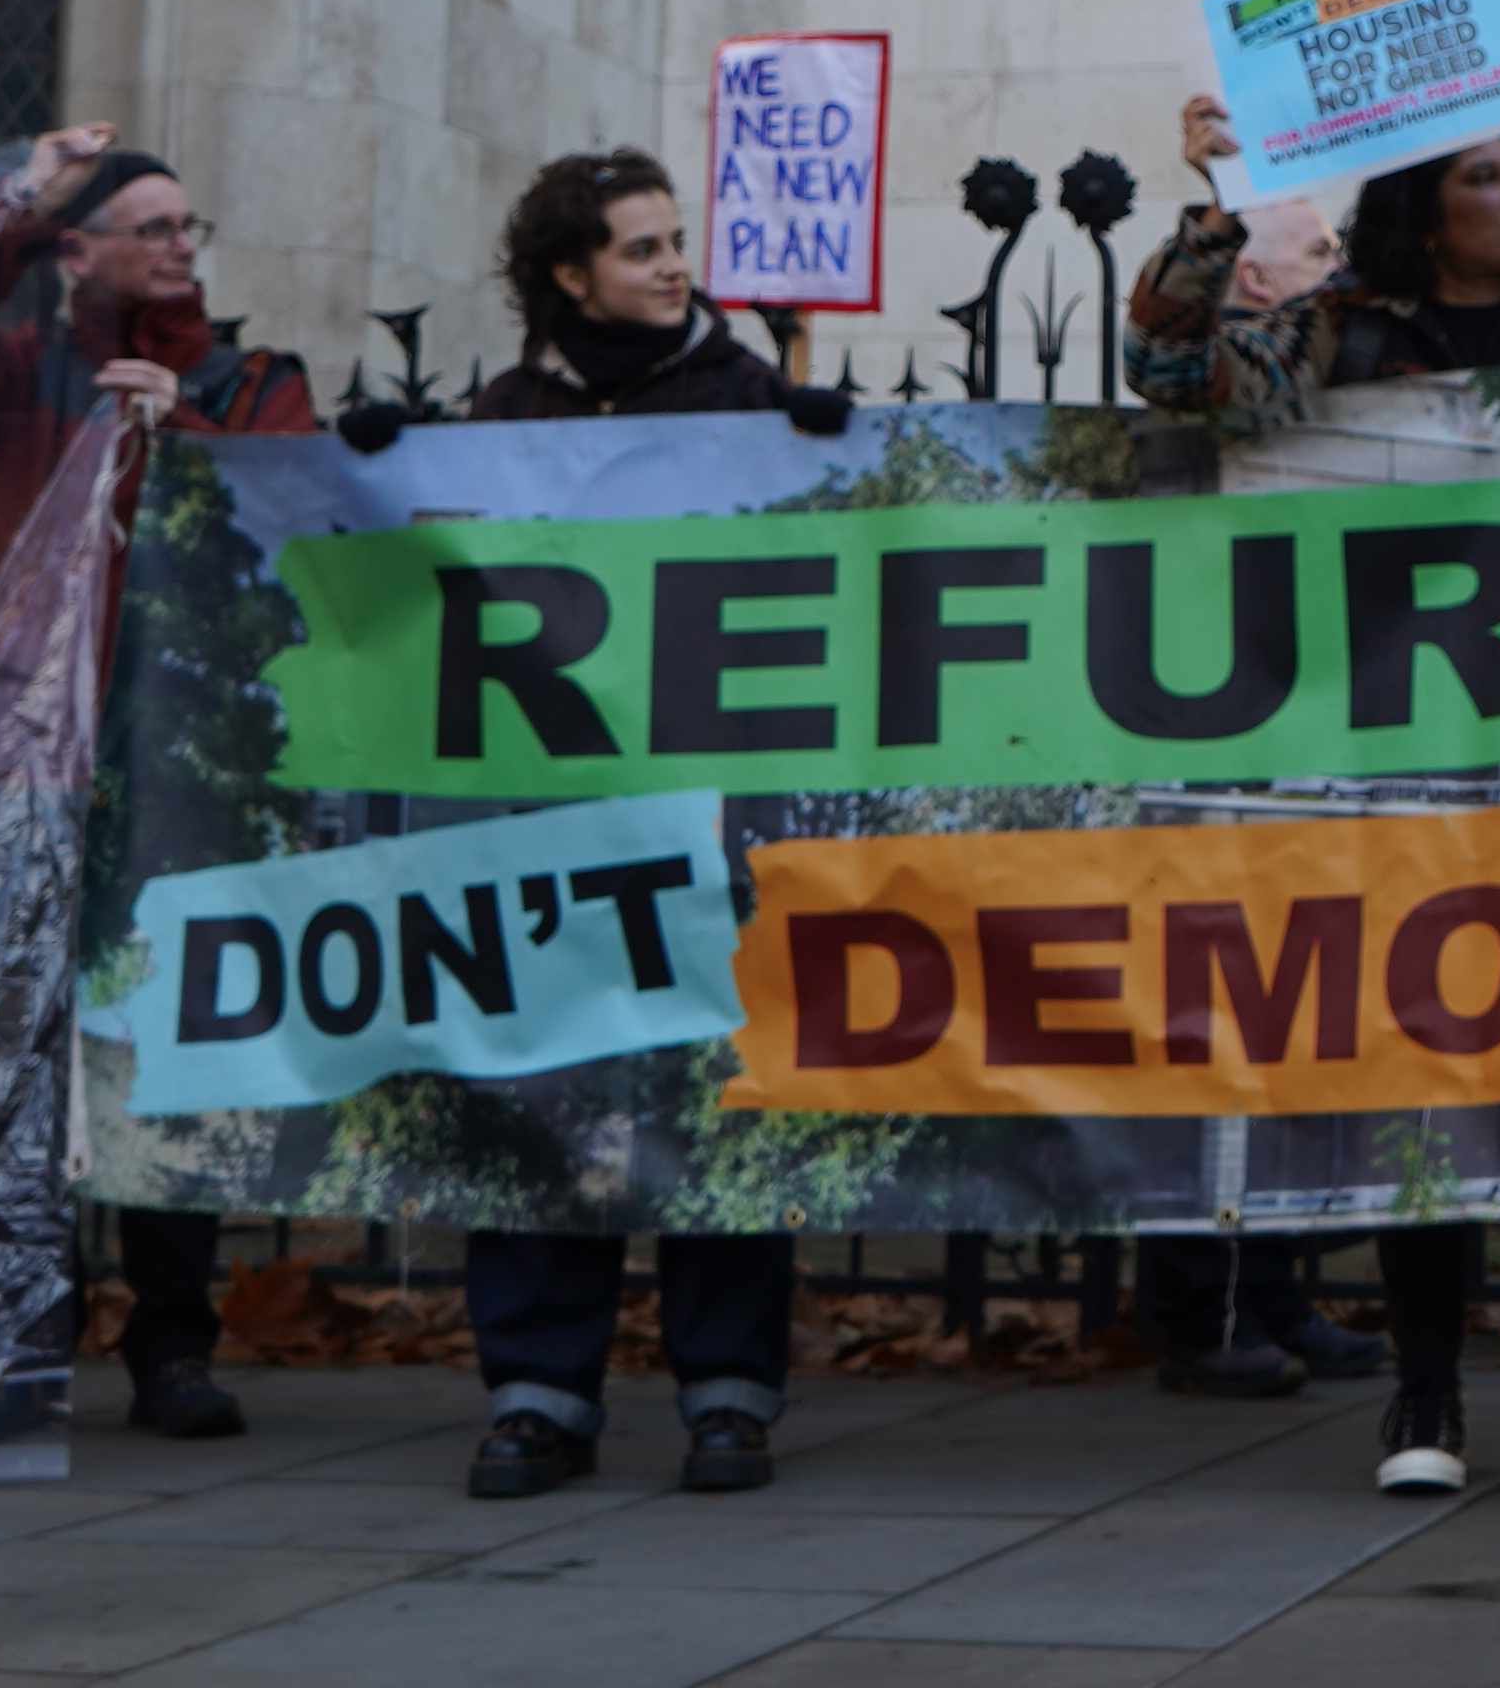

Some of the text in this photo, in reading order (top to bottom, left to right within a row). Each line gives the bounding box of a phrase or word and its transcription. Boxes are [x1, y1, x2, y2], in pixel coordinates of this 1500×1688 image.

[721, 53, 780, 97] WE
[1307, 21, 1478, 90] FOR NEED
[1316, 47, 1487, 115] NOT GREED
[731, 99, 852, 150] NEED
[719, 154, 873, 206] A NEW
[729, 216, 850, 274] PLAN
[175, 855, 695, 1045] DON'T
